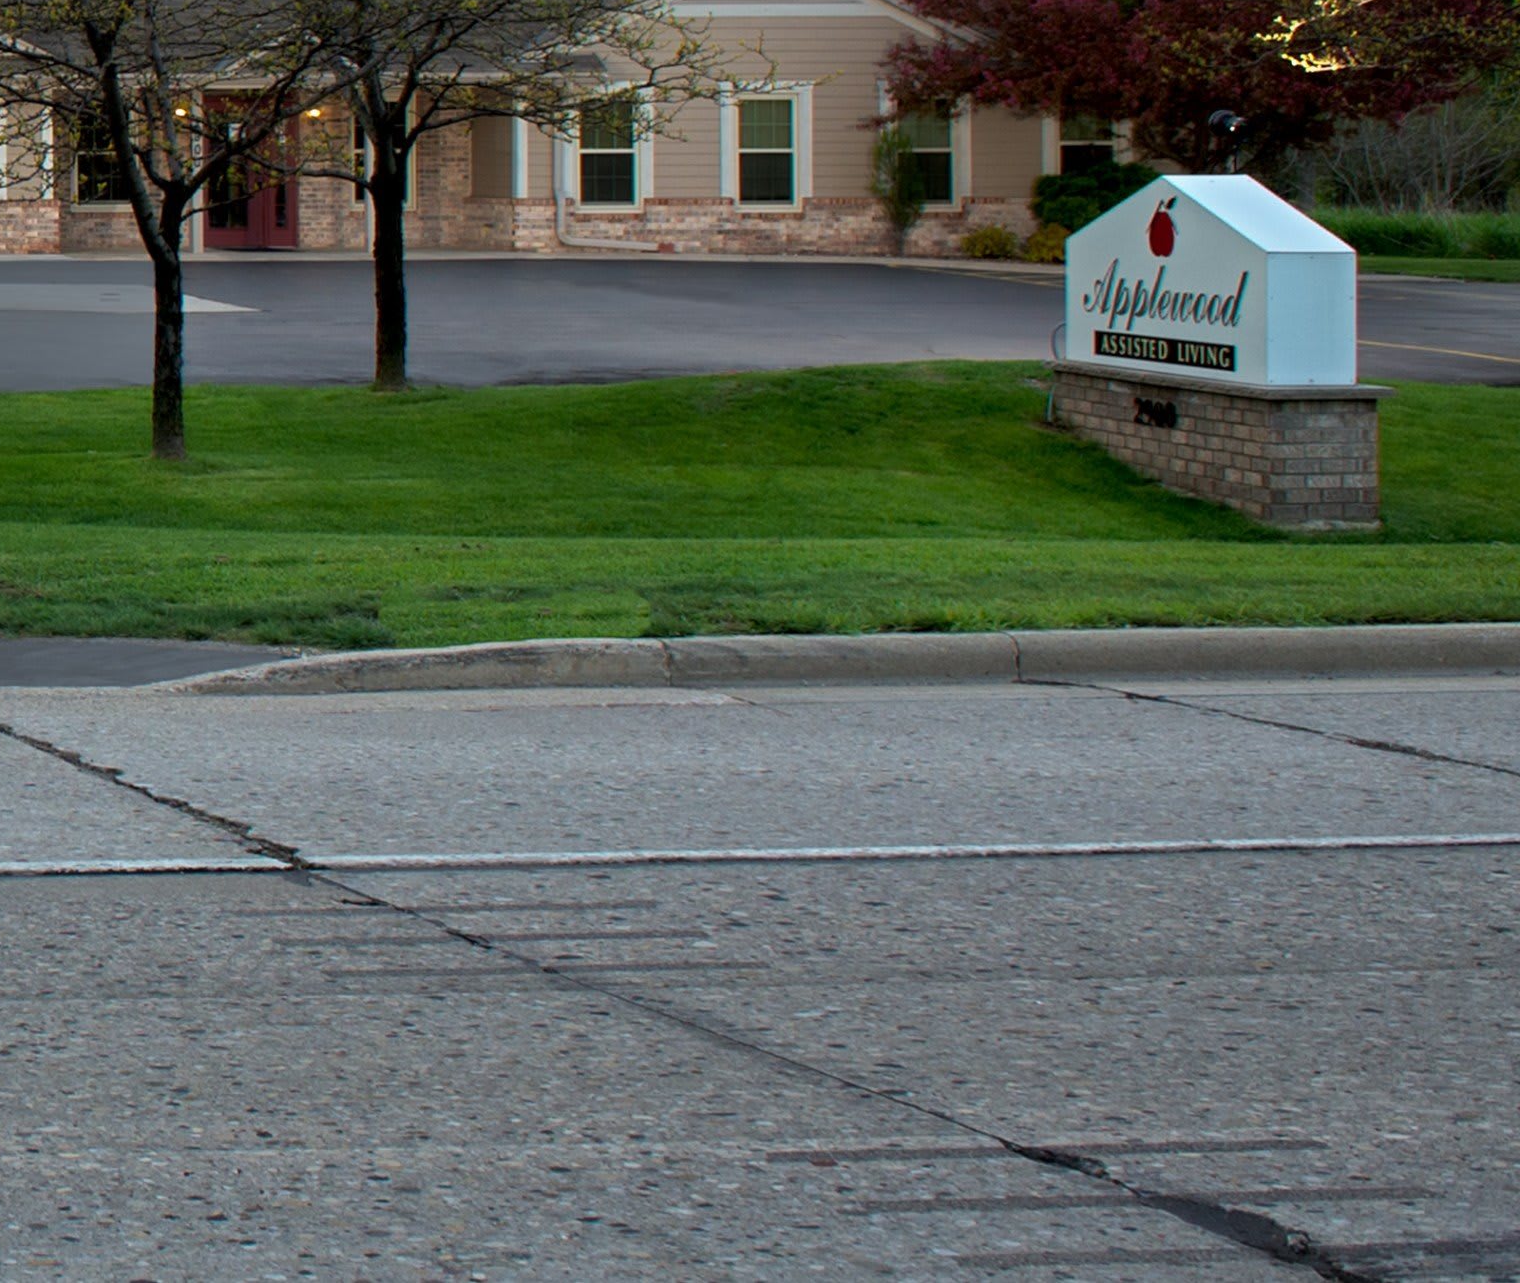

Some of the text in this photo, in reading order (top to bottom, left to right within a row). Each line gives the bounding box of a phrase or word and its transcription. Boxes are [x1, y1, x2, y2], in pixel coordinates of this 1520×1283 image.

[1082, 258, 1248, 331] Applewood
[1100, 334, 1231, 368] ASSISTED LIVING
